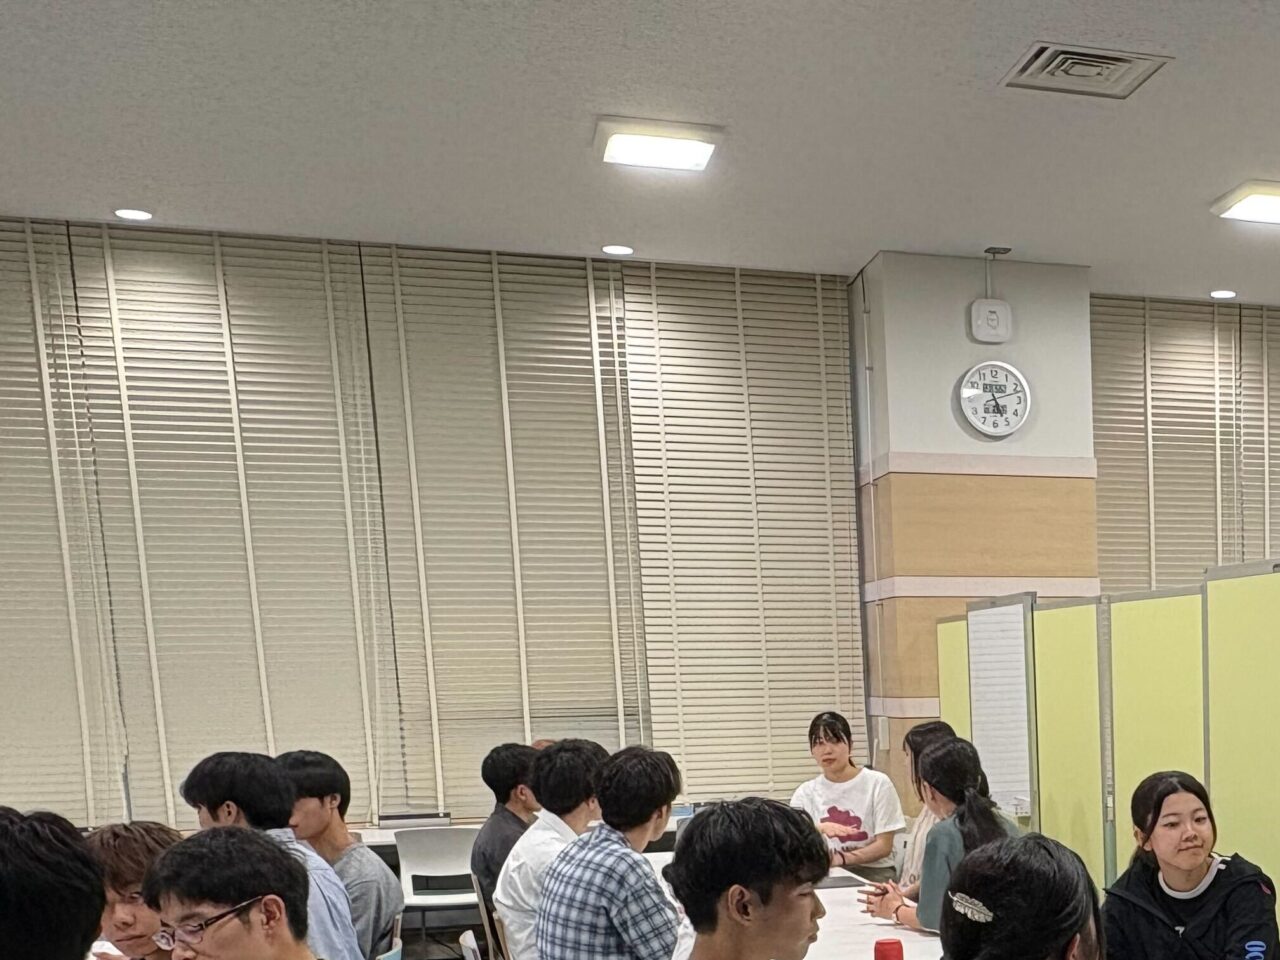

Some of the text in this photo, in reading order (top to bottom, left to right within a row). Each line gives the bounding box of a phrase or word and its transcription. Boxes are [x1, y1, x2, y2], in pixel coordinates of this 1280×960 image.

[978, 369, 986, 381] 11
[990, 370, 998, 379] 12
[1012, 383, 1019, 391] 2
[1016, 396, 1022, 405] 3
[1012, 409, 1018, 417] 4
[981, 417, 987, 425] 7
[992, 420, 999, 428] 6
[1004, 417, 1010, 426] 5
